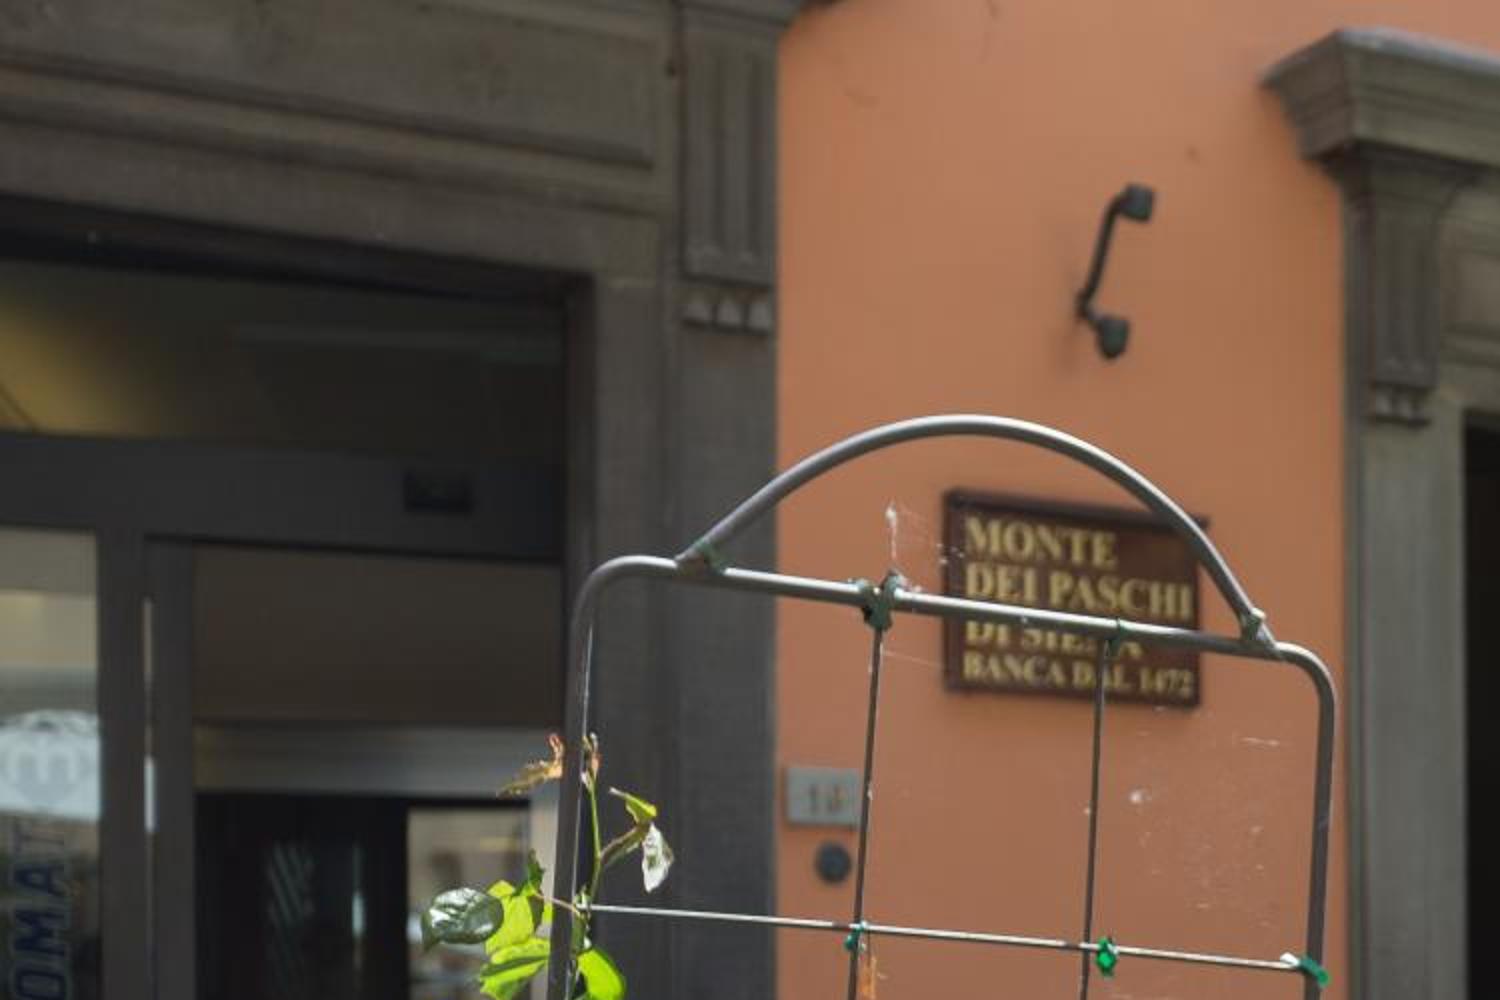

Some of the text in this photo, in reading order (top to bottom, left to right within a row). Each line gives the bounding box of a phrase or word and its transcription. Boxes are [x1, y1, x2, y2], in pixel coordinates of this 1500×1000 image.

[963, 515, 1119, 569] MONTE
[965, 562, 1194, 620] DEI PASCHI
[962, 652, 1066, 687] BANCA
[1141, 667, 1195, 699] 1472
